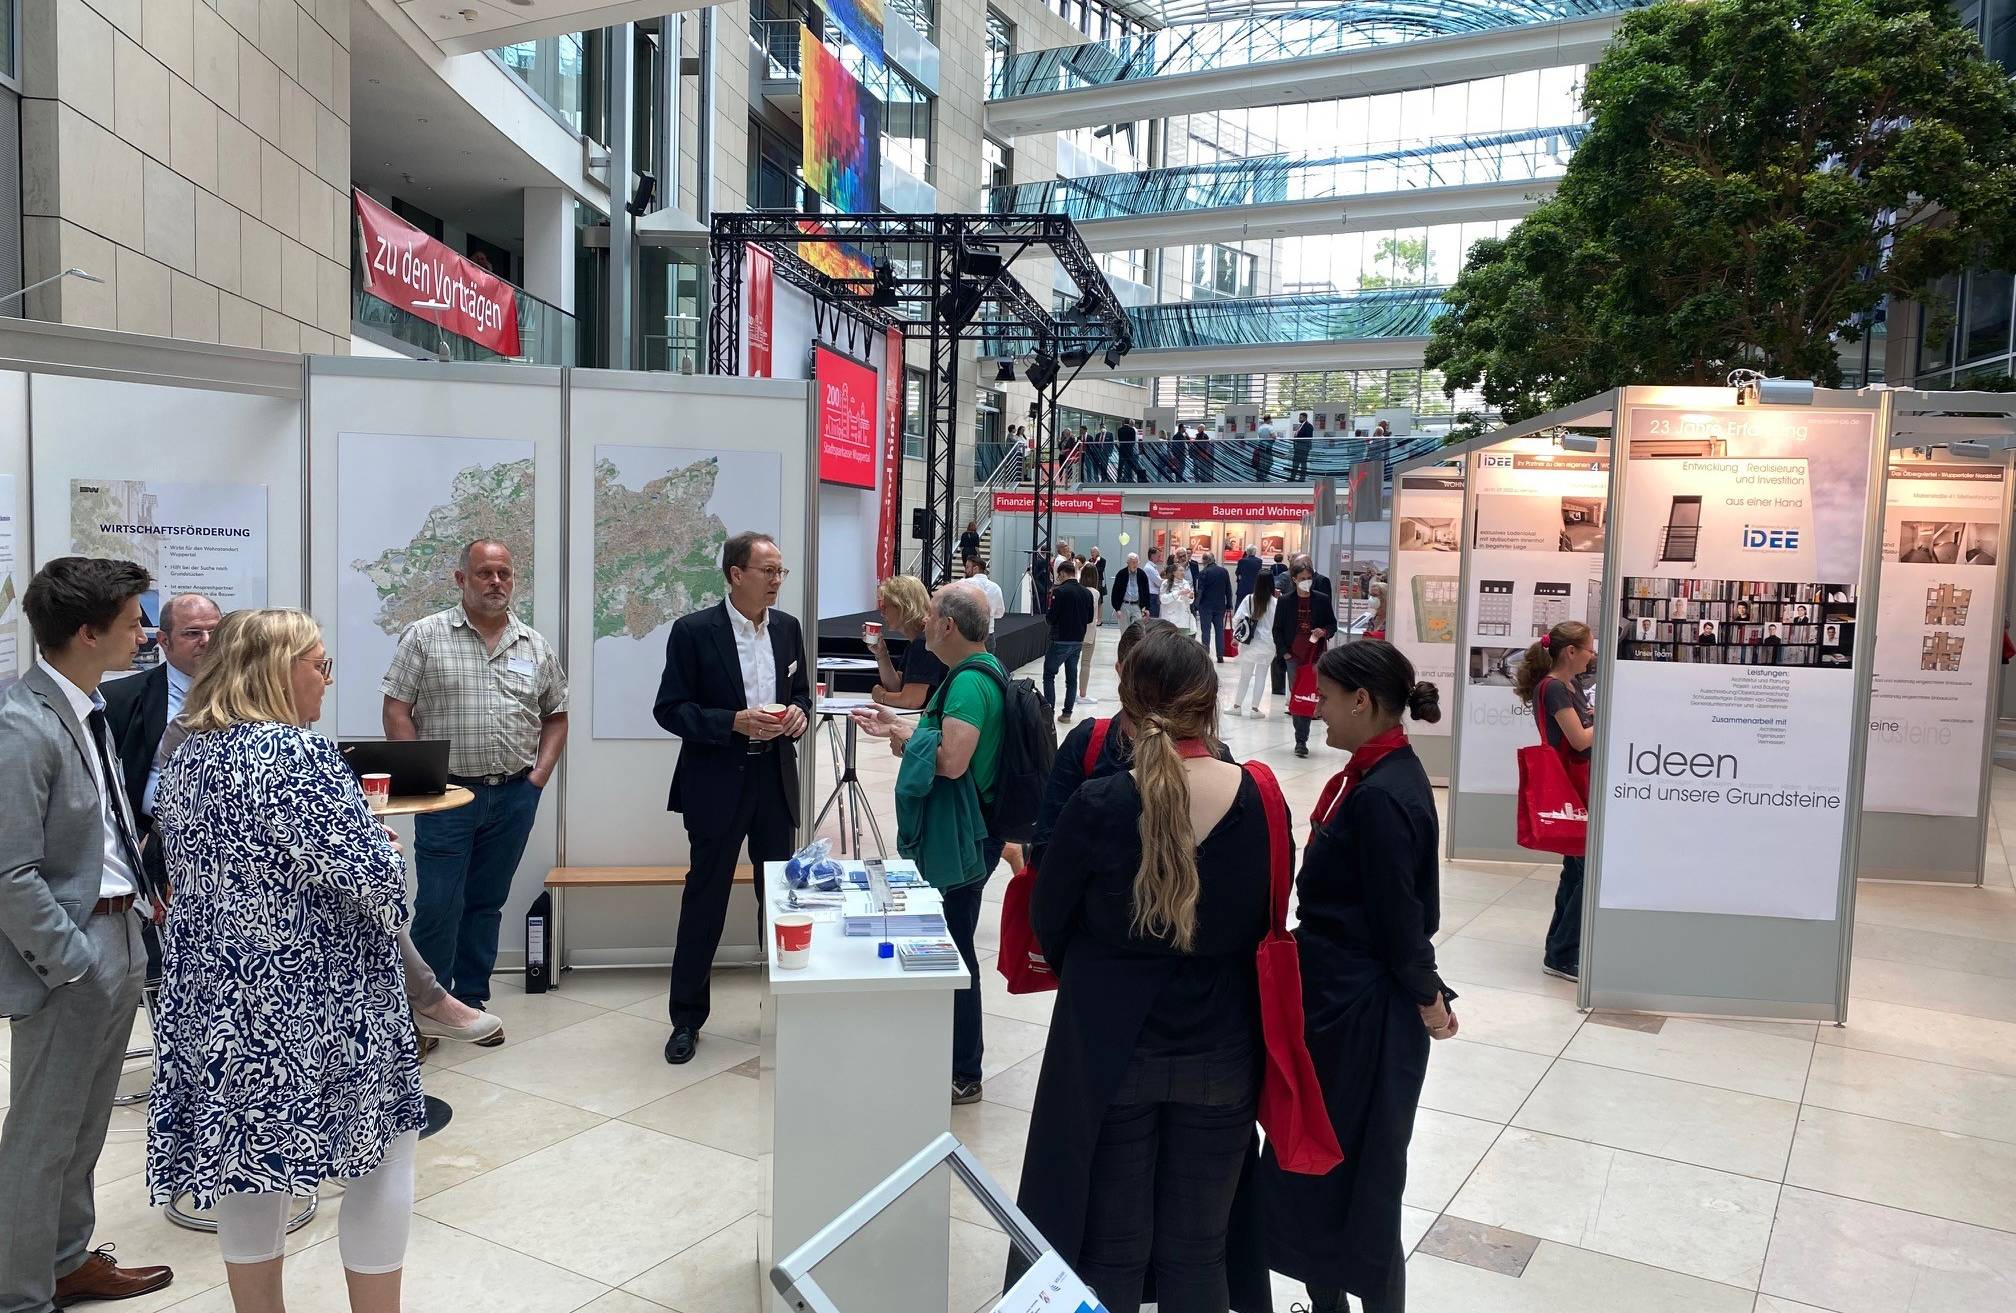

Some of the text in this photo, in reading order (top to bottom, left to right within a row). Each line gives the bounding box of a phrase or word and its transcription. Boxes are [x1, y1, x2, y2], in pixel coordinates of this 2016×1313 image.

[402, 241, 430, 295] den
[433, 259, 502, 332] Vorträgen
[826, 384, 840, 408] 200
[1649, 419, 1670, 434] 23
[1679, 419, 1722, 435] Jahre
[1728, 421, 1808, 441] Erfang
[1591, 462, 1599, 471] 4
[1747, 462, 1805, 475] Realisierung
[1735, 474, 1805, 485] und Investition
[996, 497, 1094, 509] Finanzierberatung
[1726, 497, 1803, 508] aus einer Hand
[1212, 506, 1309, 517] Bauen und Wohnen
[100, 523, 251, 538] WIRTSCHAFTSFÖRDERUNG
[1635, 649, 1673, 658] Unser Team
[1711, 715, 1774, 725] Zusammenarbeit
[1627, 742, 1738, 779] Ideen
[1614, 783, 1651, 800] sind
[1657, 786, 1720, 803] unsere
[1726, 787, 1841, 809] Grundsteine
